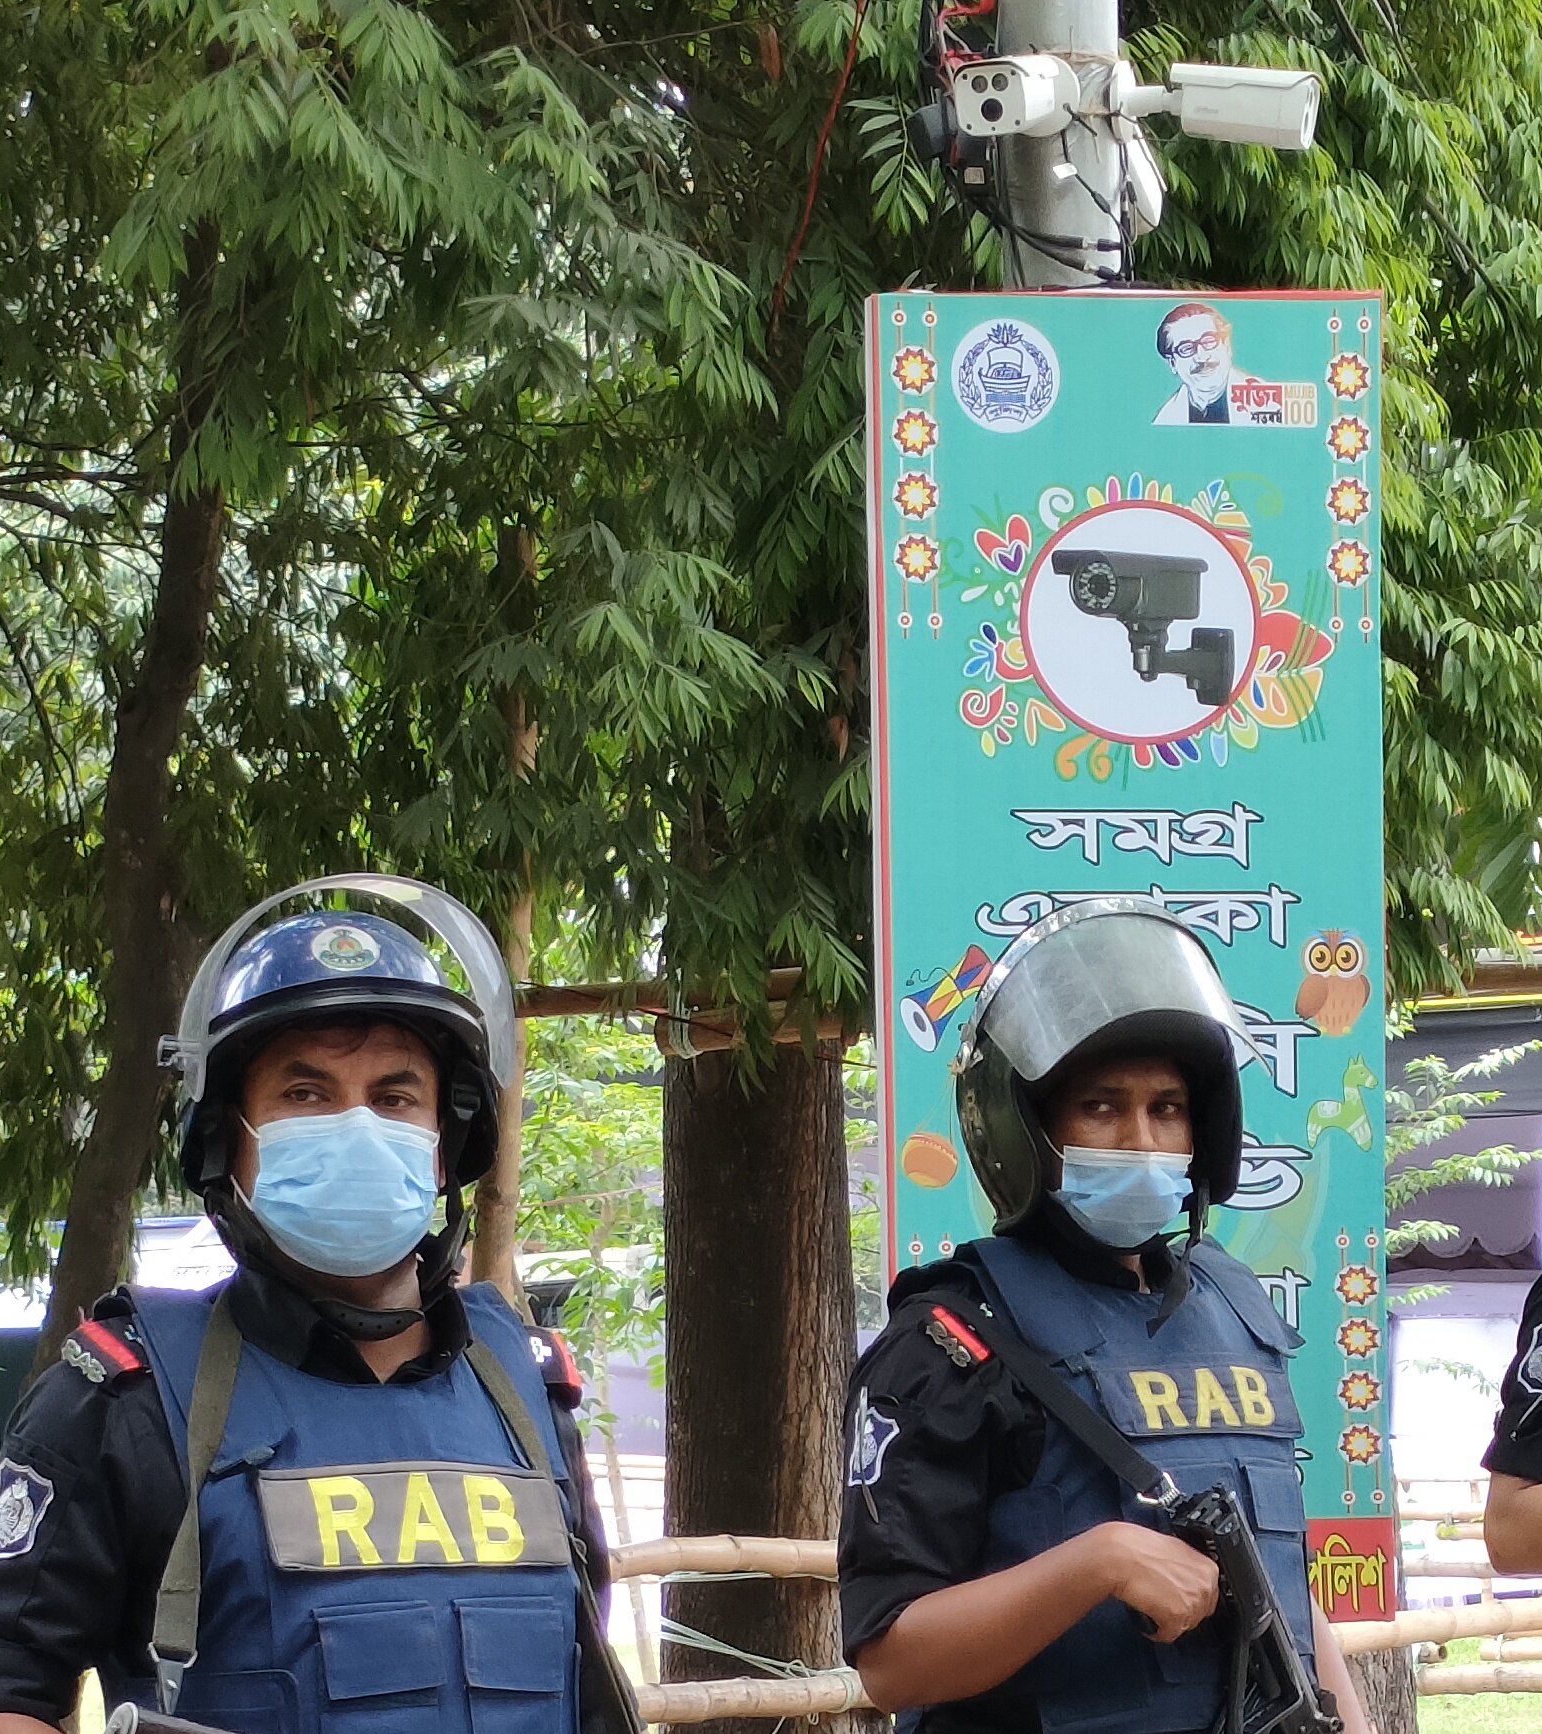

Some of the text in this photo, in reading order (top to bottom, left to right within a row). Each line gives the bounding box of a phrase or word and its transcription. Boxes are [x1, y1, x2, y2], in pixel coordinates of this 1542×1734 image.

[1284, 385, 1315, 400] MUJIB
[1284, 401, 1315, 425] 100
[1011, 801, 1263, 868] সমগ্র
[975, 884, 1301, 946] একা
[61, 1338, 108, 1383] RAB
[925, 1321, 972, 1368] RAB
[1129, 1365, 1276, 1430] RAB
[308, 1472, 526, 1567] RAB
